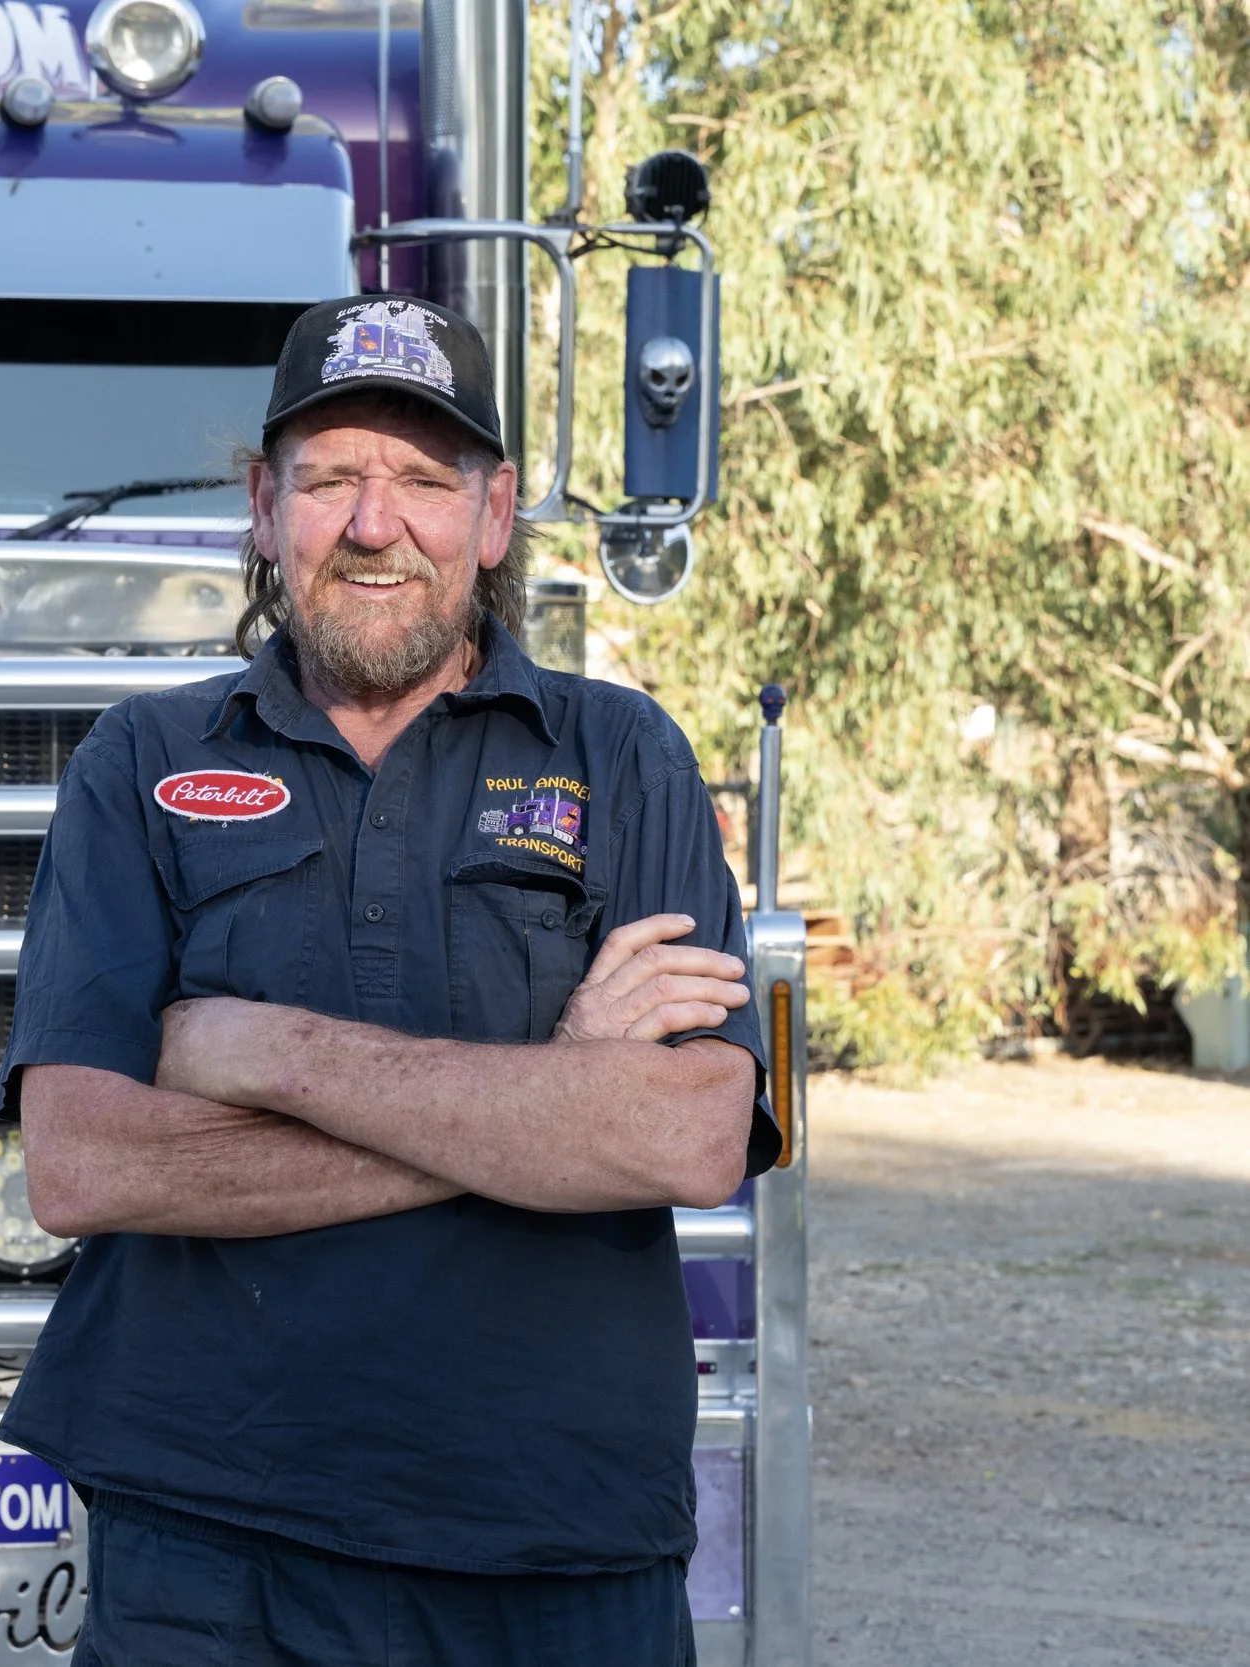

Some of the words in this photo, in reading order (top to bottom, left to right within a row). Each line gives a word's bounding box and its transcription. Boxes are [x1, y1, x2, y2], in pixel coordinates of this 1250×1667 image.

[336, 303, 372, 319] SLUDGE
[385, 301, 406, 310] THE
[407, 303, 448, 328] PHANTOM
[171, 781, 278, 806] Peterbilt
[486, 778, 528, 791] PAUL
[535, 777, 591, 801] ANDRE
[495, 838, 586, 872] TRANSPORT
